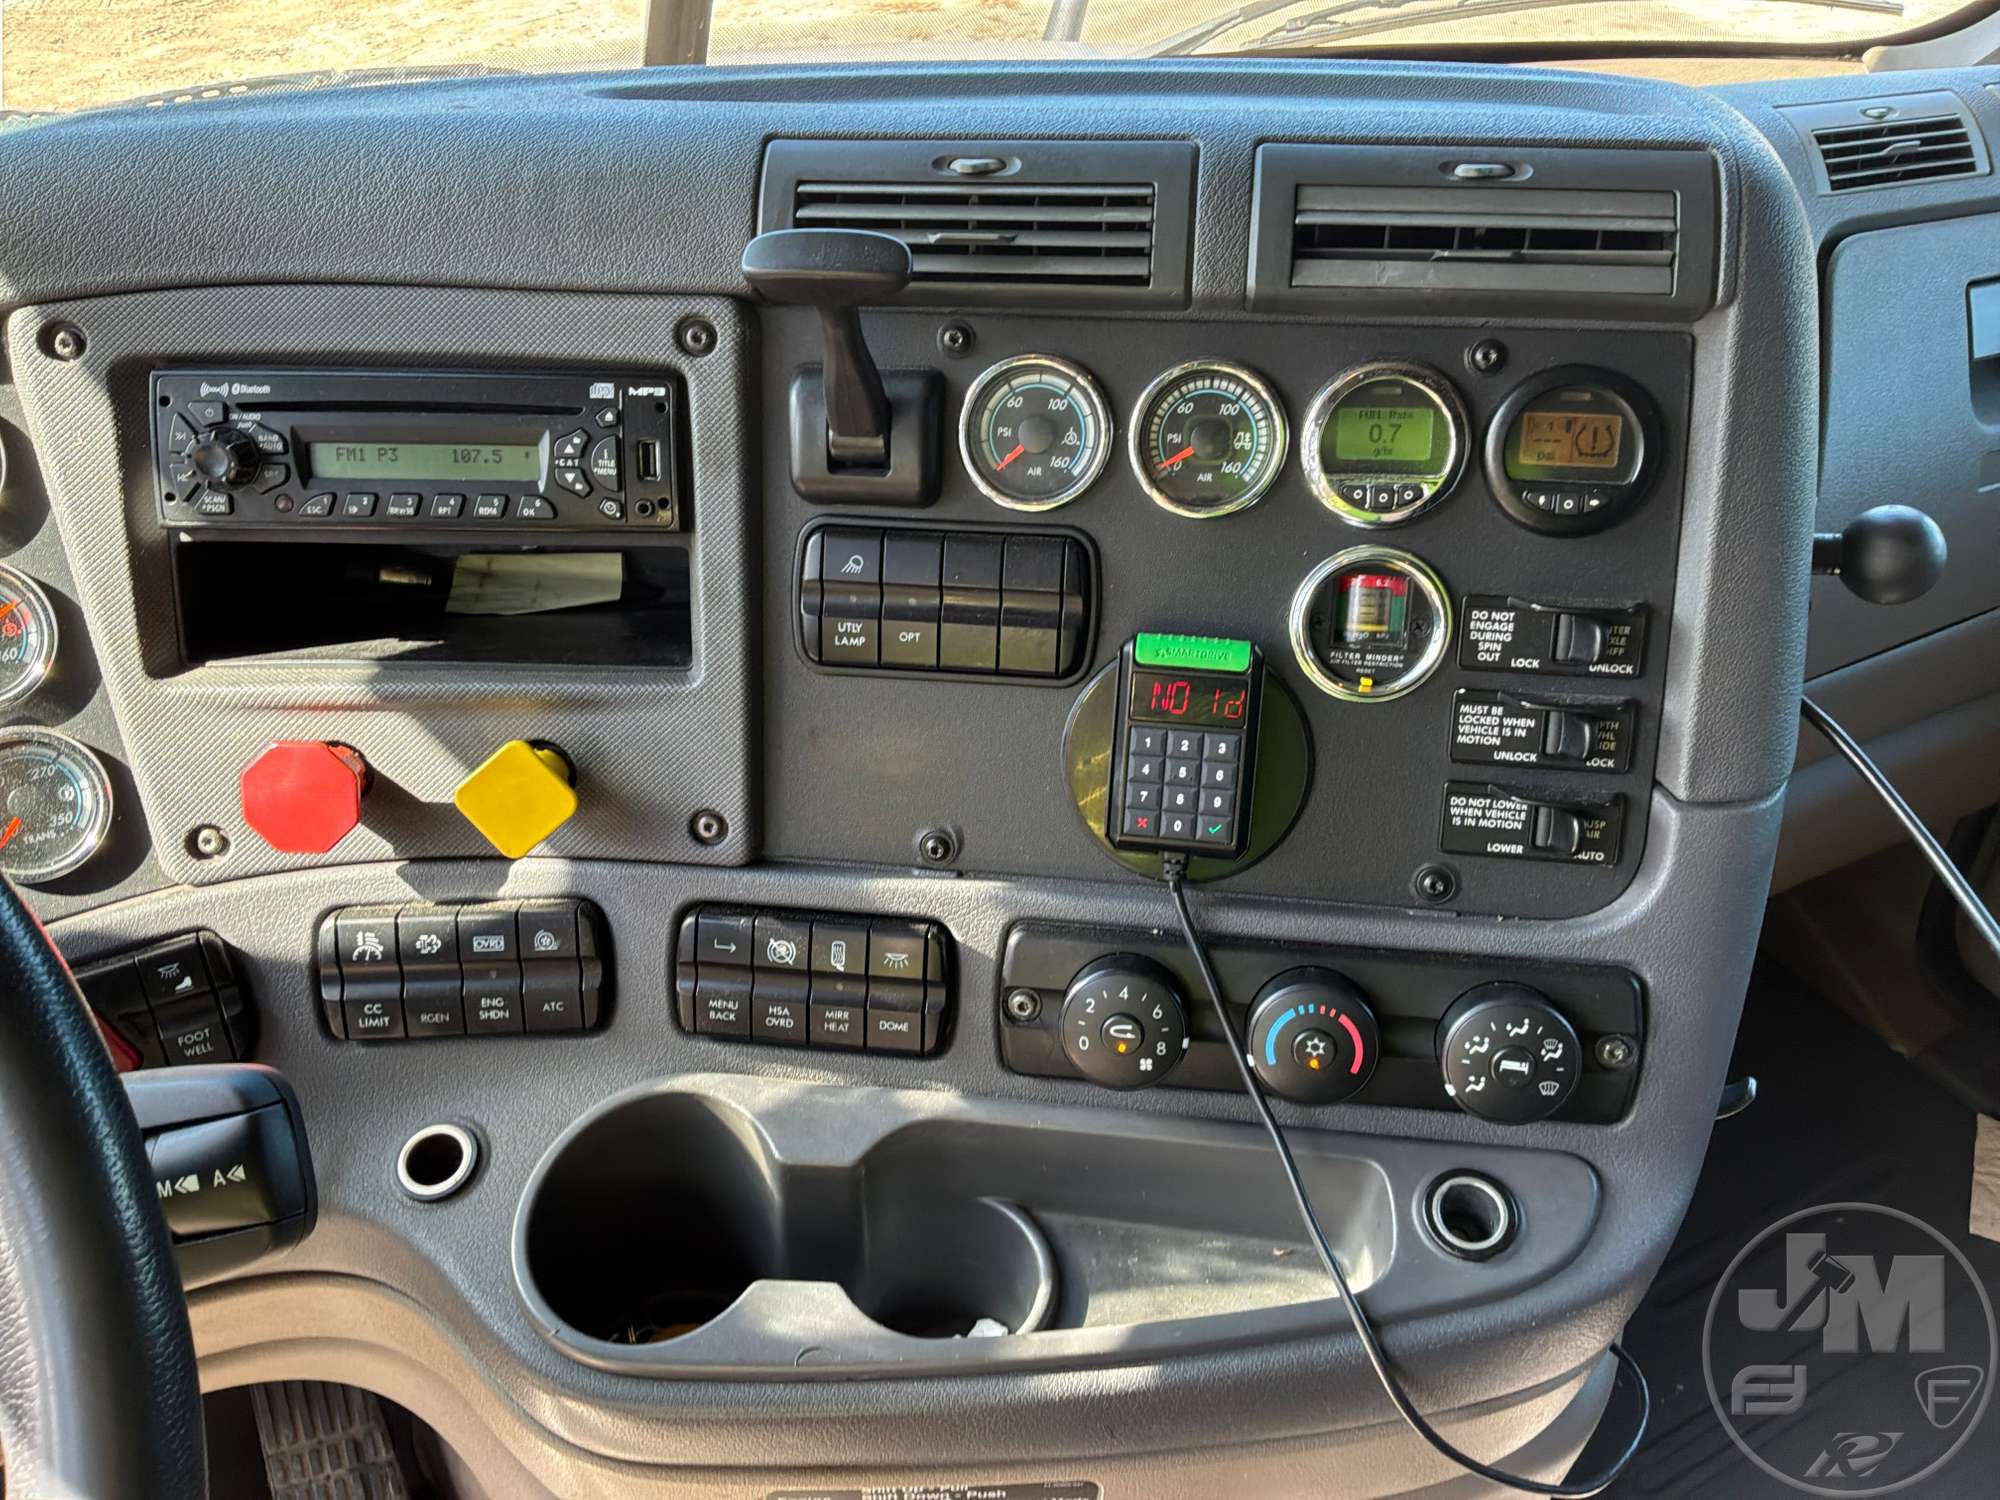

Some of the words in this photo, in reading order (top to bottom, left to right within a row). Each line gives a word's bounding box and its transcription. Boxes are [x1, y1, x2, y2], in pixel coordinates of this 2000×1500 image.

[628, 387, 666, 397] MP3
[1006, 396, 1024, 409] 60
[1047, 398, 1068, 412] 100
[1177, 401, 1194, 414] 60
[1219, 403, 1239, 417] 100
[997, 427, 1012, 438] PSI
[1368, 424, 1403, 444] 0.7
[1167, 433, 1182, 445] PSI
[336, 448, 366, 463] FM1
[377, 448, 399, 463] P3
[452, 449, 504, 464] 107.5
[1049, 455, 1071, 470] 160
[1027, 467, 1042, 478] AIR
[1221, 462, 1241, 476] 160
[1197, 473, 1213, 484] AIR
[522, 508, 535, 516] OK
[1472, 611, 1488, 620] DO
[1491, 612, 1515, 622] NOT
[838, 622, 863, 634] UTLY
[1470, 621, 1514, 632] ENGAGE
[835, 635, 866, 647] LAMP
[899, 631, 920, 643] OPT
[1470, 631, 1512, 642] DURING
[1478, 641, 1502, 651] SPIN
[1330, 651, 1361, 660] FILTER
[1477, 652, 1500, 662] OUT
[1510, 658, 1540, 669] LOCK
[1589, 663, 1633, 675] UNLOCK
[1151, 681, 1191, 715] NO
[1460, 704, 1488, 715] MUST
[1491, 706, 1503, 716] BE
[1459, 715, 1499, 726] LOCKED
[1502, 718, 1535, 728] WHEN
[1458, 725, 1499, 736] VEHICLE
[1502, 728, 1511, 737] IS
[1514, 728, 1527, 737] IN
[1144, 737, 1151, 748] 1
[1180, 739, 1189, 751] 2
[1457, 735, 1500, 746] MOTION
[1218, 743, 1226, 755] 3
[1494, 752, 1537, 763] UNLOCK
[31, 765, 56, 781] 270
[1141, 764, 1150, 776] 4
[1178, 766, 1187, 778] 5
[1215, 769, 1224, 781] 6
[1140, 791, 1148, 802] 7
[1176, 794, 1184, 806] 8
[1213, 796, 1222, 808] 9
[1450, 796, 1466, 807] DO
[1468, 798, 1490, 808] NOT
[1493, 800, 1529, 811] LOWER
[51, 812, 74, 828] 350
[1450, 807, 1482, 817] WHEN
[1485, 810, 1527, 821] VEHICLE
[1173, 820, 1182, 832] 0
[1452, 817, 1462, 826] IS
[1464, 818, 1475, 828] IN
[1478, 819, 1522, 831] MOTION
[23, 830, 57, 846] TRANS
[1487, 843, 1524, 854] LOWER
[475, 938, 503, 950] OVRD
[1118, 985, 1129, 1000] 4
[481, 997, 504, 1008] ENG
[543, 1001, 564, 1013] ATC
[709, 1000, 738, 1011] MENU
[1086, 998, 1096, 1014] 2
[364, 1003, 382, 1015] CC
[479, 1009, 509, 1021] SHDN
[769, 1005, 790, 1017] HSA
[1152, 1003, 1163, 1019] 6
[421, 1012, 450, 1023] RGEN
[709, 1011, 736, 1023] BACK
[825, 1010, 849, 1021] MIRR
[359, 1016, 390, 1028] LIMIT
[766, 1017, 794, 1029] OVRD
[824, 1021, 849, 1033] HEAT
[879, 1021, 909, 1033] DOME
[178, 1028, 211, 1047] FOOT
[1078, 1035, 1089, 1051] 0
[183, 1042, 214, 1057] WELL
[1156, 1041, 1166, 1056] 8
[213, 1168, 226, 1188] A
[156, 1180, 173, 1199] M
[966, 1489, 1007, 1499] Push
